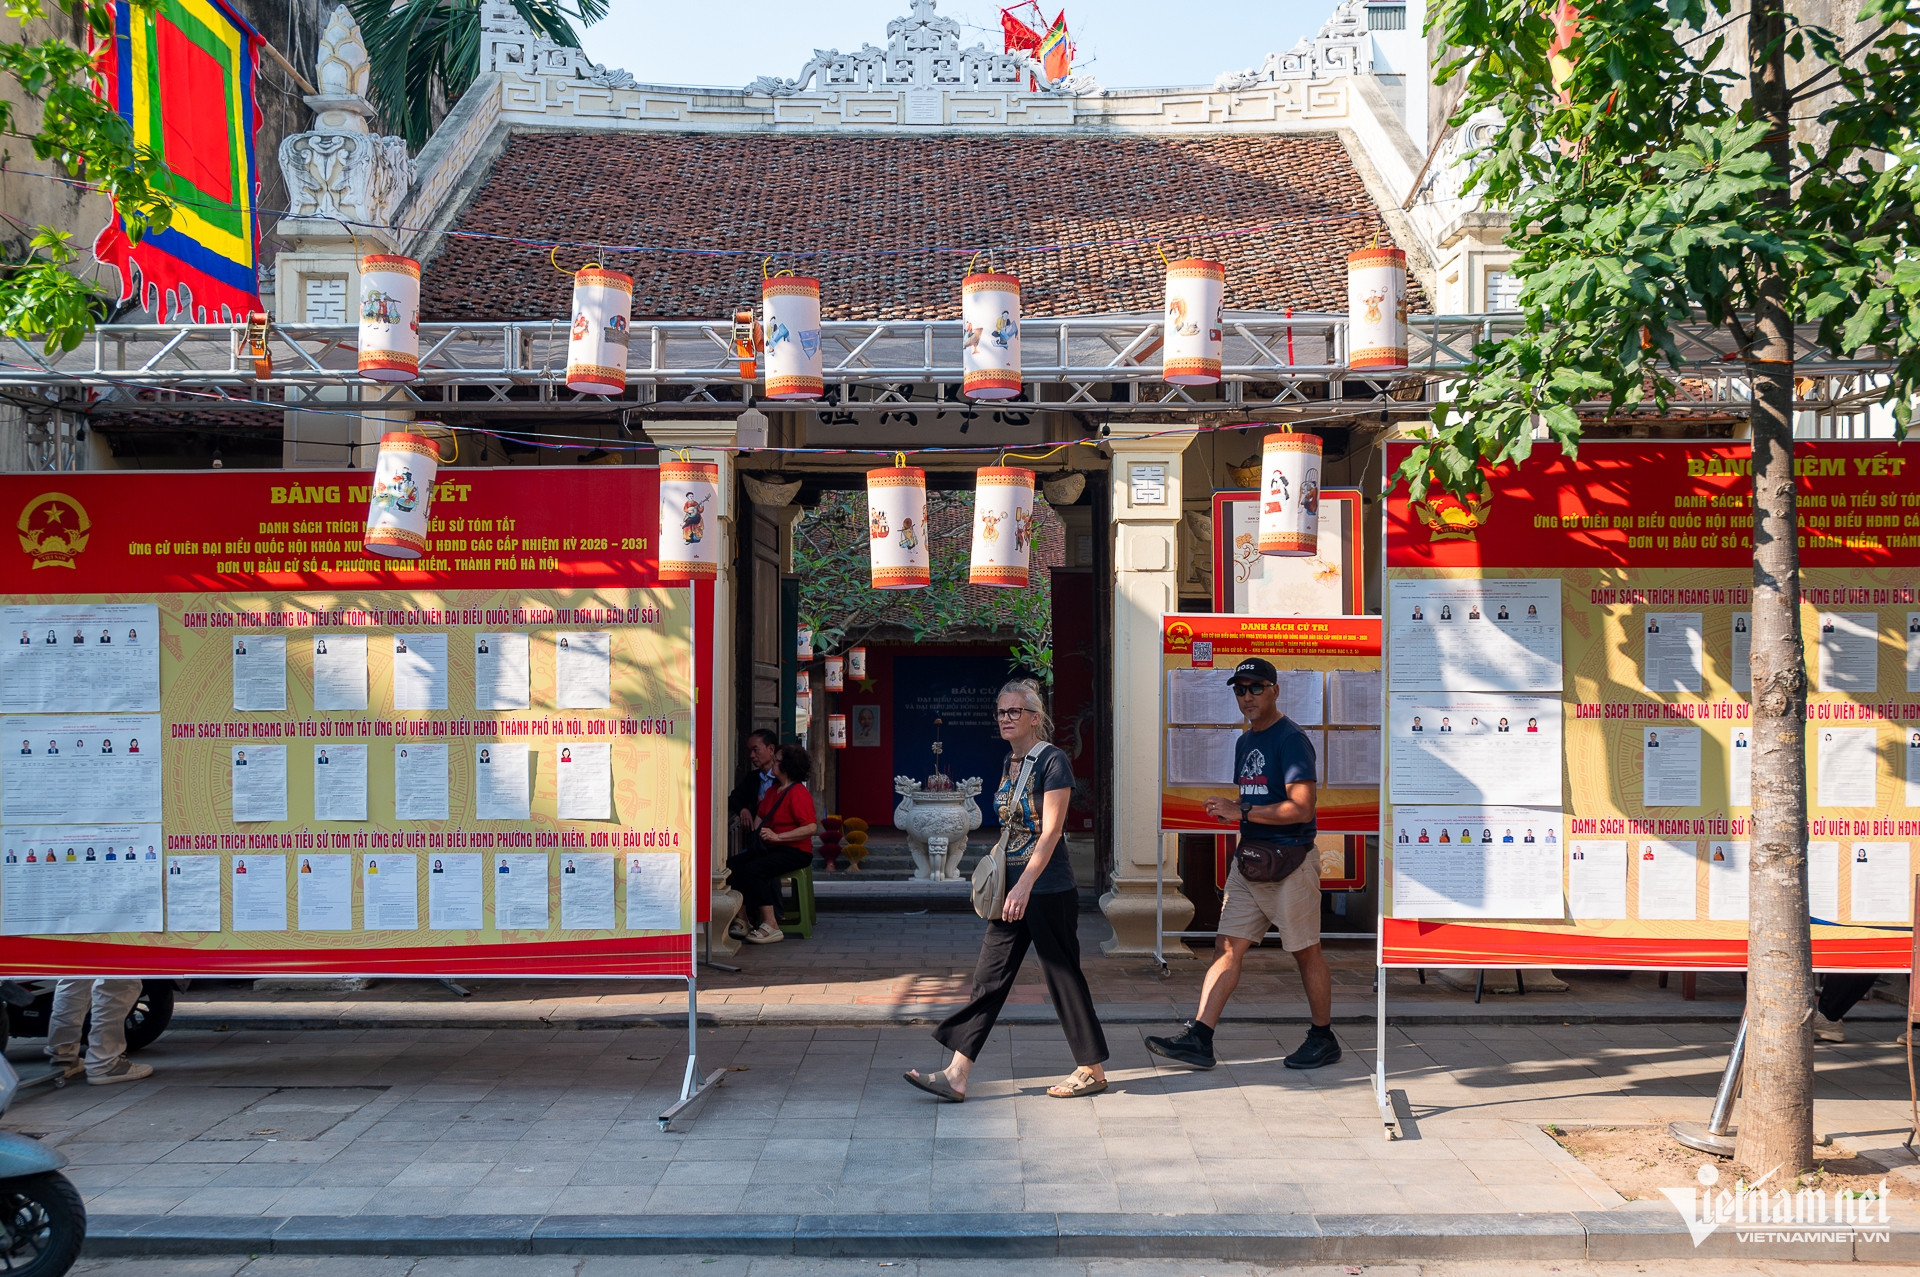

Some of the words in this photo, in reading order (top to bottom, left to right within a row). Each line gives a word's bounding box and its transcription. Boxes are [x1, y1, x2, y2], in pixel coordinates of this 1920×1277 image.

[1794, 454, 1846, 476] IÊM
[1854, 451, 1906, 476] YẾT
[271, 481, 340, 503] BẢNG
[1674, 496, 1706, 507] DANH
[1711, 493, 1743, 507] SÁCH
[1796, 495, 1827, 507] GANG
[1831, 492, 1846, 507] VÀ
[1850, 490, 1876, 507] TIỂU
[1880, 491, 1897, 507] SỬ
[259, 522, 289, 534] DANH
[292, 519, 321, 533] SÁCH
[325, 518, 358, 533] TRÍCH
[427, 515, 446, 532] IỂU
[449, 516, 465, 532] SỬ
[467, 517, 493, 532] TÓM
[496, 514, 516, 531] TẮT
[1533, 513, 1558, 528] ỨNG
[1562, 512, 1579, 528] CỬ
[1582, 513, 1609, 528] VIÊN
[1613, 516, 1633, 531] ĐẠI
[1638, 511, 1665, 528] BIỂU
[1669, 510, 1702, 528] QUỐC
[1706, 513, 1726, 530] HỘI
[1730, 513, 1754, 527] KHÓ
[1797, 513, 1805, 527] À
[1809, 516, 1830, 530] ĐẠI
[1834, 510, 1862, 527] BIỂU
[1866, 516, 1900, 527] HĐND
[1904, 513, 1920, 527] CÁ
[129, 541, 151, 555] ỨNG
[155, 539, 170, 554] CỬ
[174, 540, 199, 554] VIÊN
[202, 543, 221, 557] ĐẠI
[225, 537, 250, 554] BIỂU
[254, 537, 284, 553] QUỐC
[288, 539, 307, 556] HỘI
[311, 539, 341, 553] KHÓA
[344, 541, 362, 552] XVI
[436, 540, 467, 552] HĐND
[471, 537, 493, 551] CÁC
[496, 534, 519, 551] CẤP
[522, 537, 559, 554] NHIỆM
[562, 536, 577, 550] KỲ
[580, 539, 608, 550] 2026
[621, 538, 648, 550] 2031
[1628, 536, 1653, 548] ĐƠN
[1657, 536, 1669, 551] VỊ
[1673, 531, 1697, 548] BẦU
[1701, 532, 1718, 548] CỬ
[1721, 531, 1737, 548] SỐ
[1741, 536, 1753, 549] 4,
[1810, 533, 1842, 548] HOÀN
[1846, 530, 1882, 549] KIẾM,
[217, 561, 240, 573] ĐƠN
[243, 561, 254, 576] VỊ
[258, 555, 281, 573] BẦU
[284, 557, 300, 573] CỬ
[303, 555, 318, 572] SỐ
[321, 560, 332, 574] 4,
[335, 557, 381, 572] PHƯỜNG
[418, 554, 451, 572] KIẾM,
[454, 556, 491, 571] THÀNH
[494, 553, 517, 570] PHỐ
[522, 555, 535, 570] HÀ
[539, 555, 559, 573] NỘI
[1591, 589, 1616, 604] DANH
[1620, 586, 1644, 604] SÁCH
[1647, 586, 1674, 604] TRÍCH
[1678, 589, 1710, 604] NGANG
[1712, 586, 1725, 604] VÀ
[1727, 582, 1748, 604] TIỂU
[1810, 586, 1830, 604] ỨNG
[1833, 584, 1846, 604] CỬ
[1848, 586, 1869, 604] VIÊN
[1873, 589, 1889, 607] ĐẠI
[1893, 582, 1914, 604] BIỂU
[184, 612, 207, 627] DANH
[210, 609, 233, 627] SÁCH
[236, 609, 262, 627] TRÍCH
[265, 612, 294, 627] NGANG
[297, 608, 308, 626] VÀ
[311, 604, 330, 626] TIỂU
[332, 607, 345, 626] SỬ
[346, 608, 366, 626] TÓM
[369, 604, 384, 626] TẮT
[387, 608, 404, 626] ỨNG
[407, 606, 420, 626] CỬ
[422, 607, 442, 625] VIÊN
[444, 610, 460, 628] ĐẠI
[463, 603, 483, 625] BIỂU
[486, 603, 510, 625] QUỐC
[512, 607, 527, 628] HỘI
[530, 607, 553, 624] KHÓA
[556, 609, 571, 624] XVI
[574, 609, 592, 624] ĐƠN
[594, 609, 604, 627] VỊ
[606, 602, 624, 624] BẦU
[627, 604, 640, 624] CỬ
[642, 602, 653, 624] SỐ
[655, 609, 660, 624] 1
[1270, 622, 1294, 631] SÁCH
[1297, 622, 1310, 631] CỬ
[168, 835, 192, 849] DANH
[194, 832, 218, 849] SÁCH
[220, 832, 246, 849] TRÍCH
[249, 834, 278, 849] NGANG
[281, 831, 293, 849] VÀ
[295, 827, 314, 849] TIỂU
[316, 830, 329, 849] SỬ
[331, 831, 350, 848] TÓM
[353, 827, 368, 848] TẮT
[371, 831, 389, 848] ỨNG
[391, 829, 404, 848] CỬ
[406, 831, 426, 848] VIÊN
[429, 834, 444, 851] ĐẠI
[447, 826, 467, 848] BIỂU
[470, 833, 494, 848] HĐND
[497, 830, 532, 848] PHƯỜNG
[535, 830, 558, 847] HOÀN
[561, 826, 588, 848] KIẾM,
[590, 833, 609, 847] ĐƠN
[611, 833, 620, 850] VỊ
[623, 826, 641, 847] BẦU
[643, 828, 656, 847] CỬ
[658, 826, 670, 847] SỐ
[673, 832, 679, 847] 4
